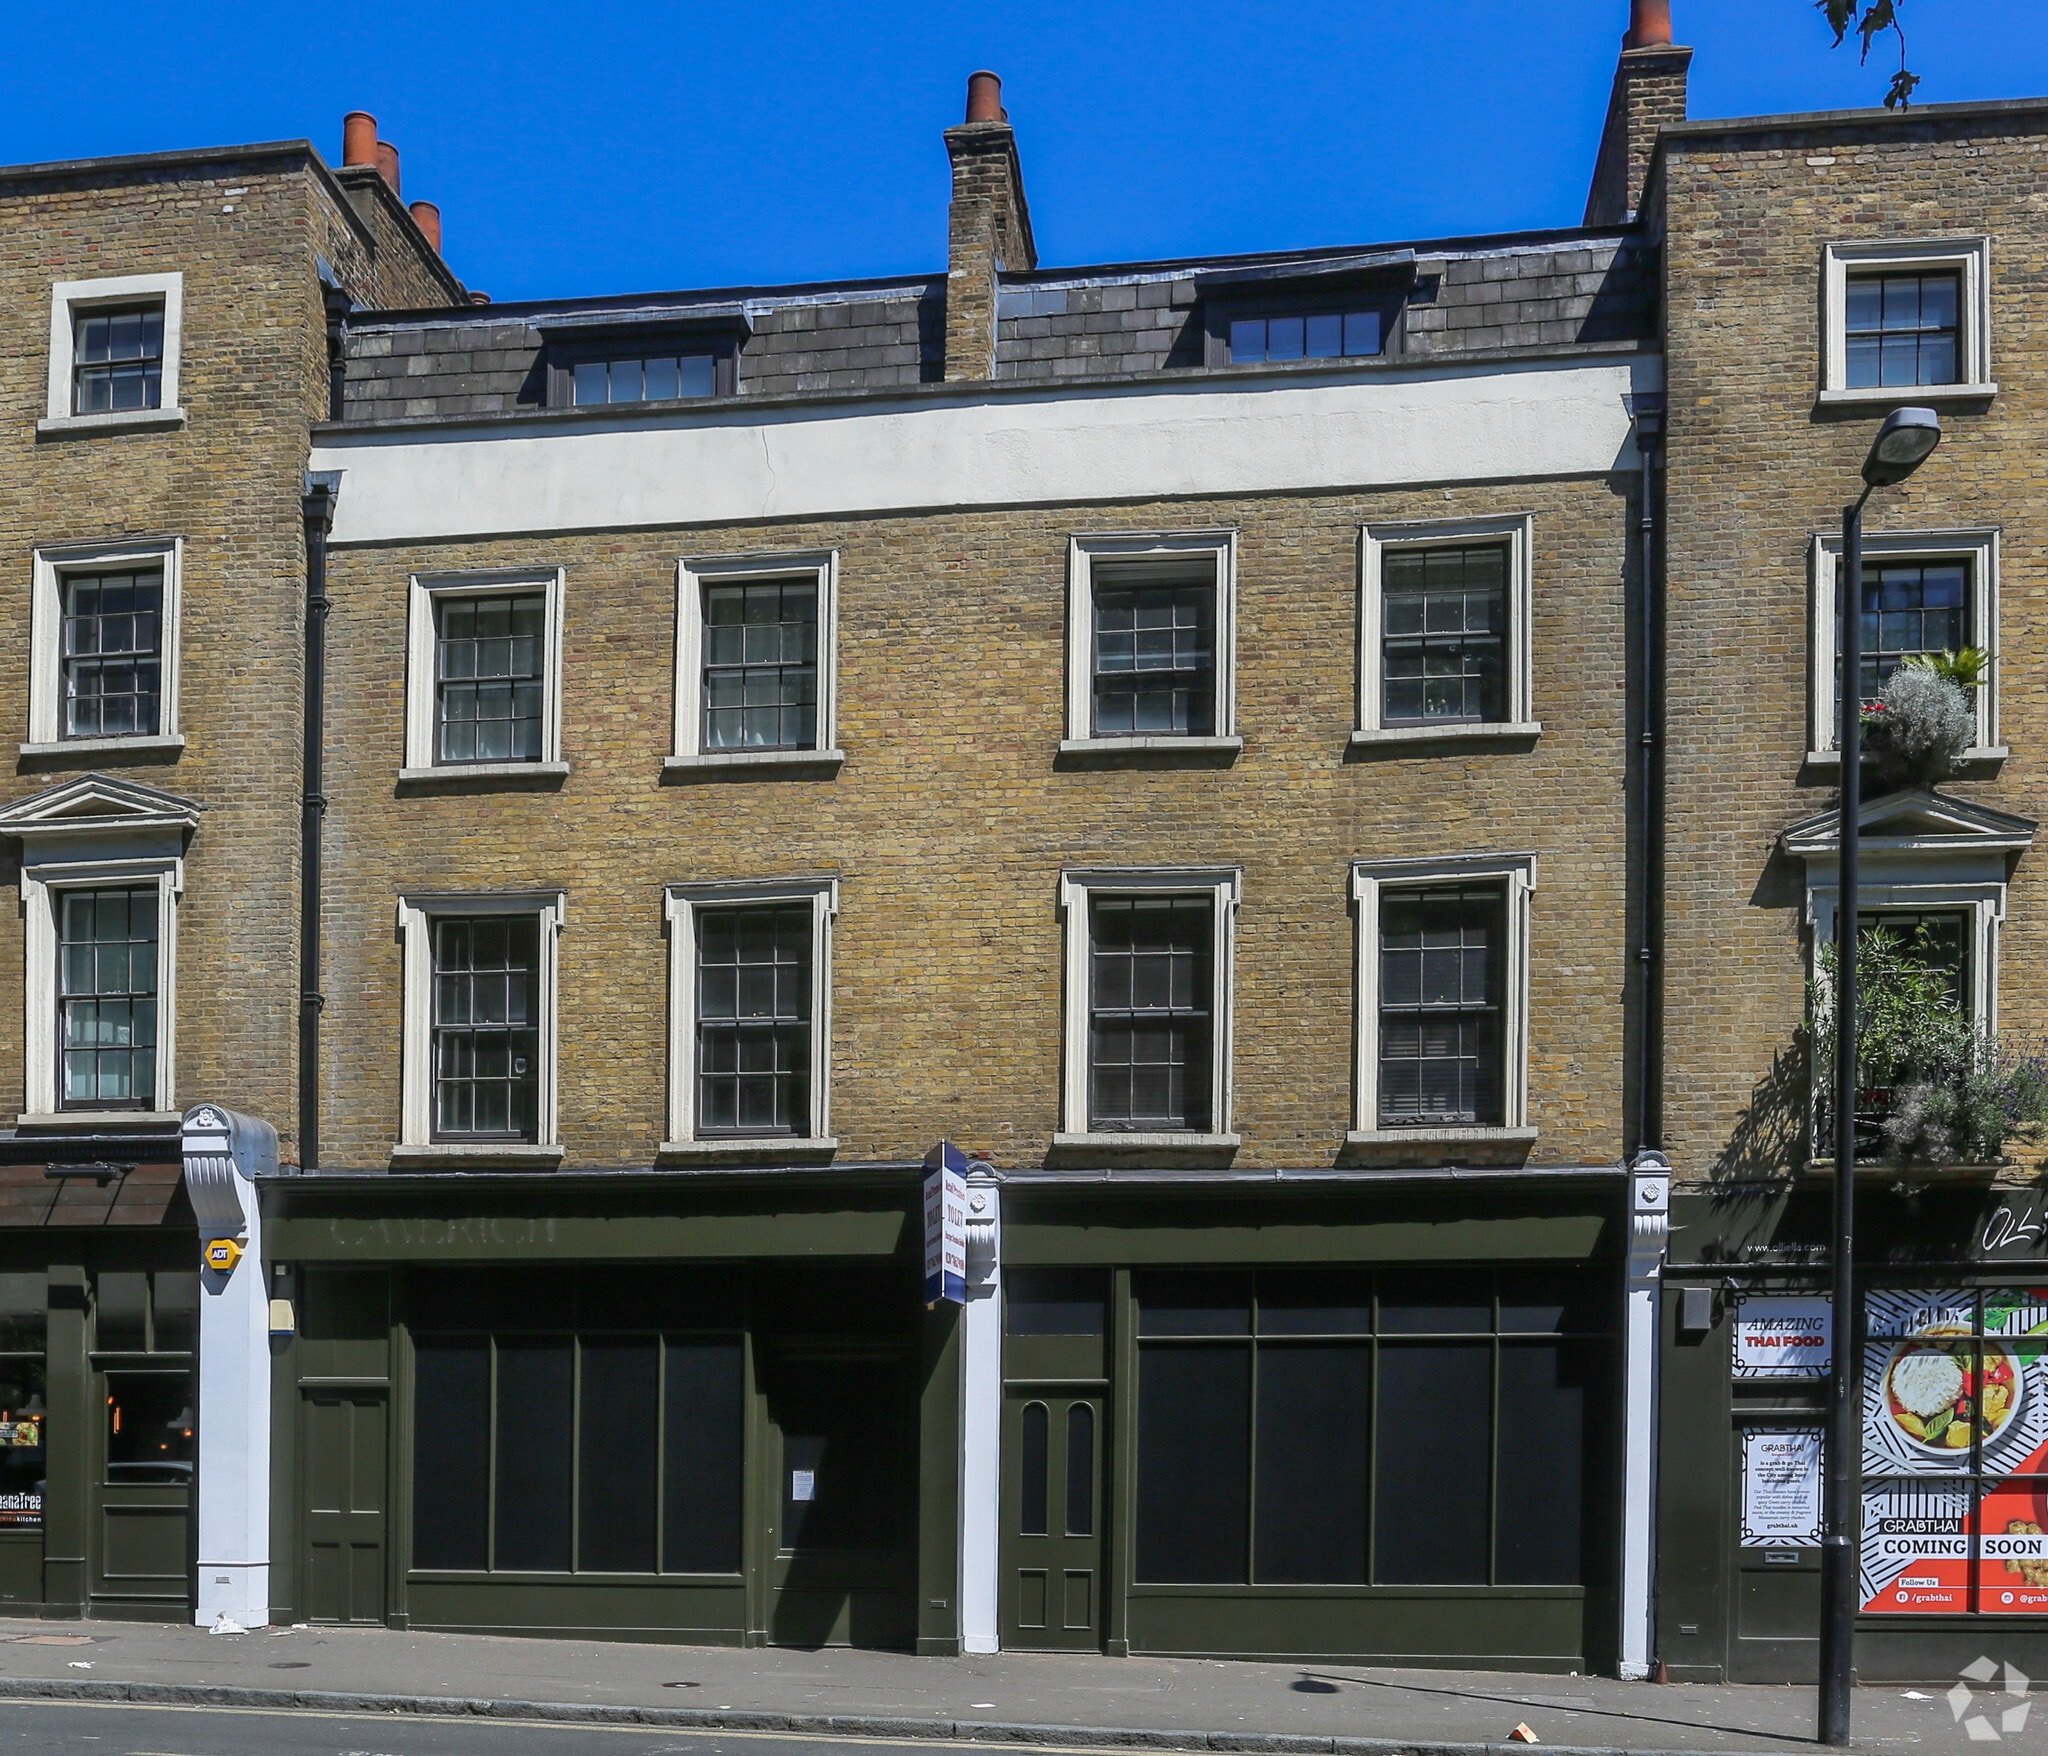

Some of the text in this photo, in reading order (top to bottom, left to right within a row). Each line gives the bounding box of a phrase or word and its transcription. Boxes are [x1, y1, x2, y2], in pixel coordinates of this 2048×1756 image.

[948, 1203, 963, 1228] TO LET
[211, 1248, 228, 1259] ADT
[1747, 1317, 1824, 1331] AMAZING
[1745, 1335, 1825, 1347] THAI FOOD
[1761, 1444, 1804, 1452] GRABTHAI
[1883, 1520, 1959, 1533] GRABTHAI
[1884, 1540, 2043, 1554] COMING SOON
[1911, 1593, 1953, 1603] /grabthai
[2019, 1593, 2048, 1604] @grab
